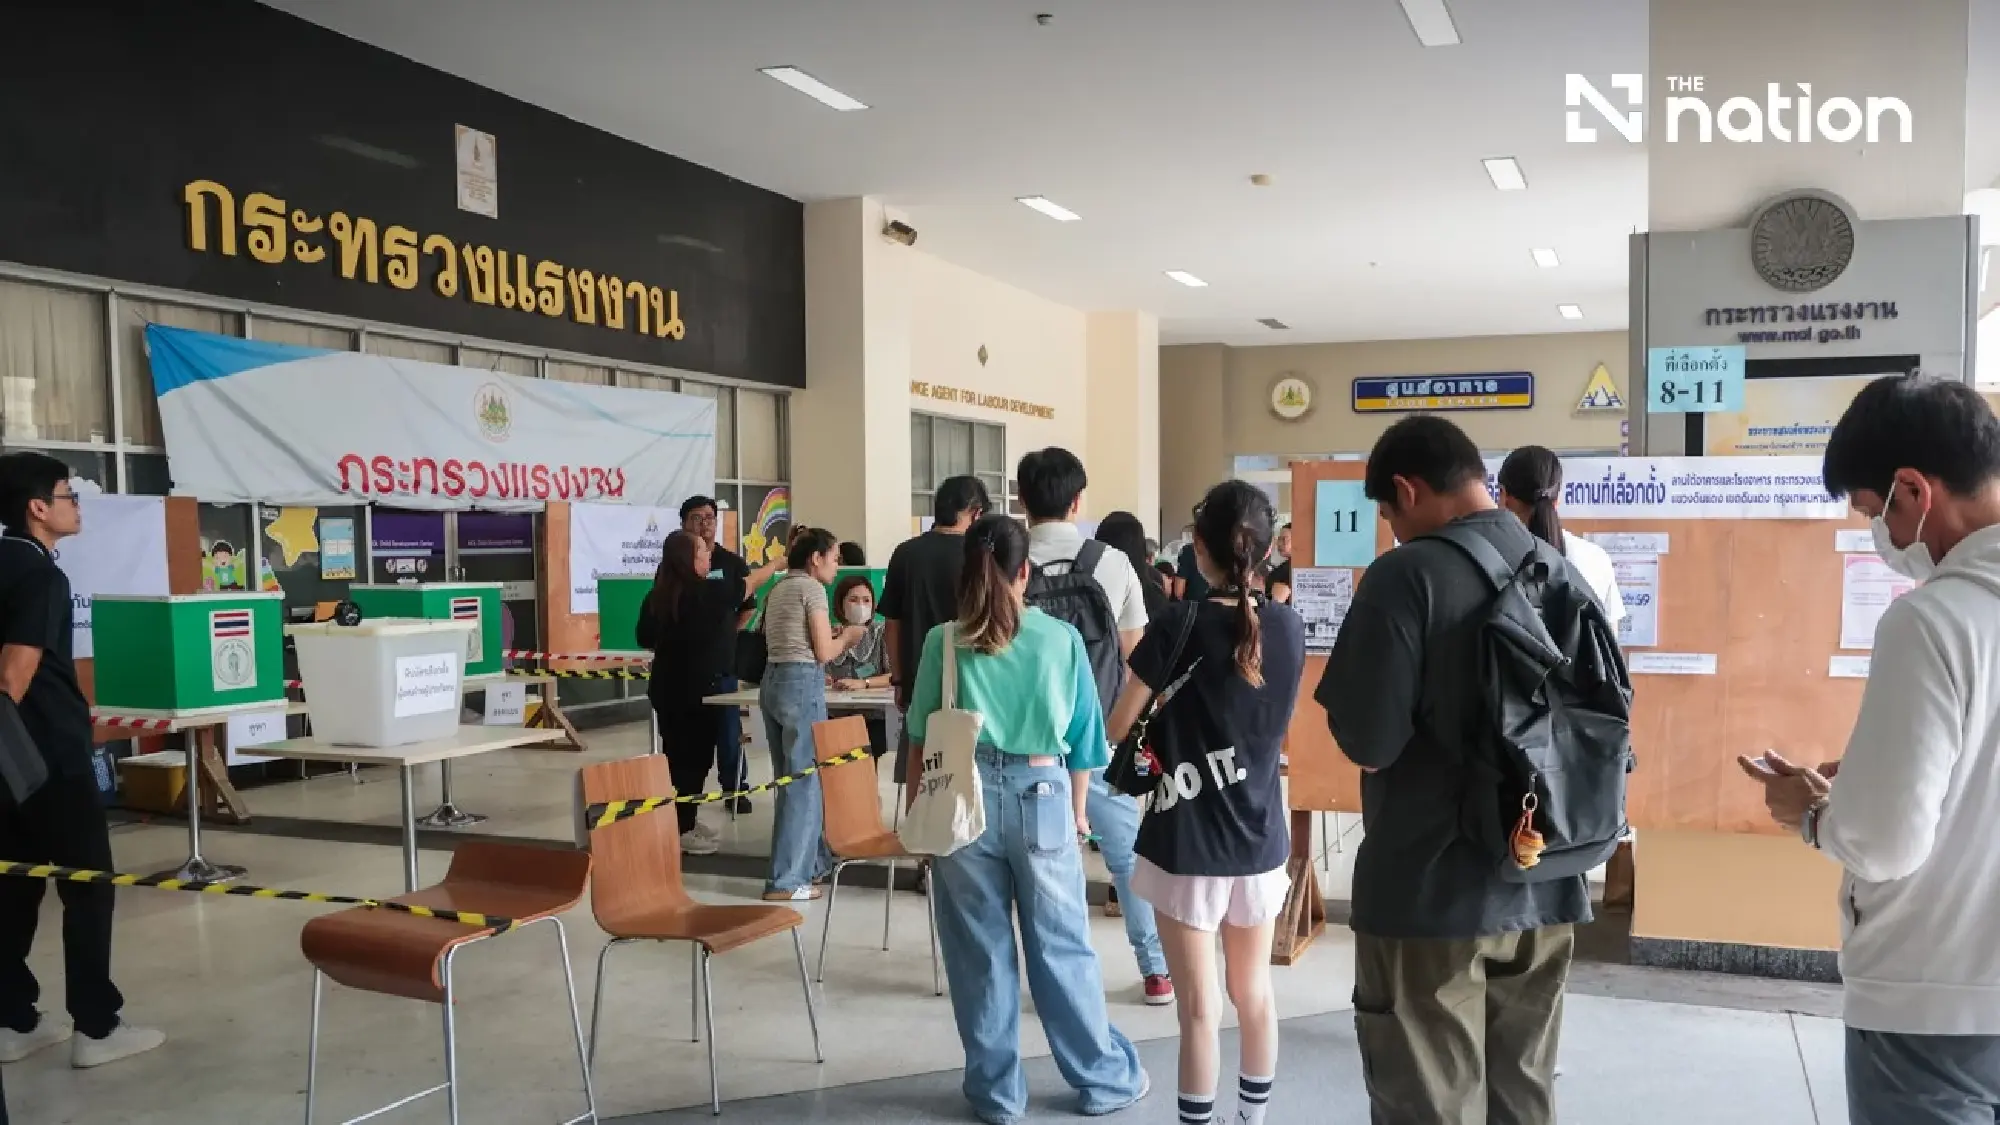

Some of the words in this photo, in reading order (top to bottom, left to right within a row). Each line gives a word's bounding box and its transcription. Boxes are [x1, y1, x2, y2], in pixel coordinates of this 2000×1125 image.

[184, 179, 686, 341] กระทรวงแรงงาน
[1705, 301, 1899, 326] กระทรวงแรงงาน
[1665, 348, 1728, 372] ที่เลือกตั้ง
[1660, 380, 1723, 404] 8-11
[337, 453, 626, 500] กระทรวงแรงงาน
[1565, 465, 1666, 505] สถานที่เลือกตั้ง
[1333, 510, 1359, 532] 11
[921, 751, 943, 772] ril
[1206, 746, 1247, 790] IT.
